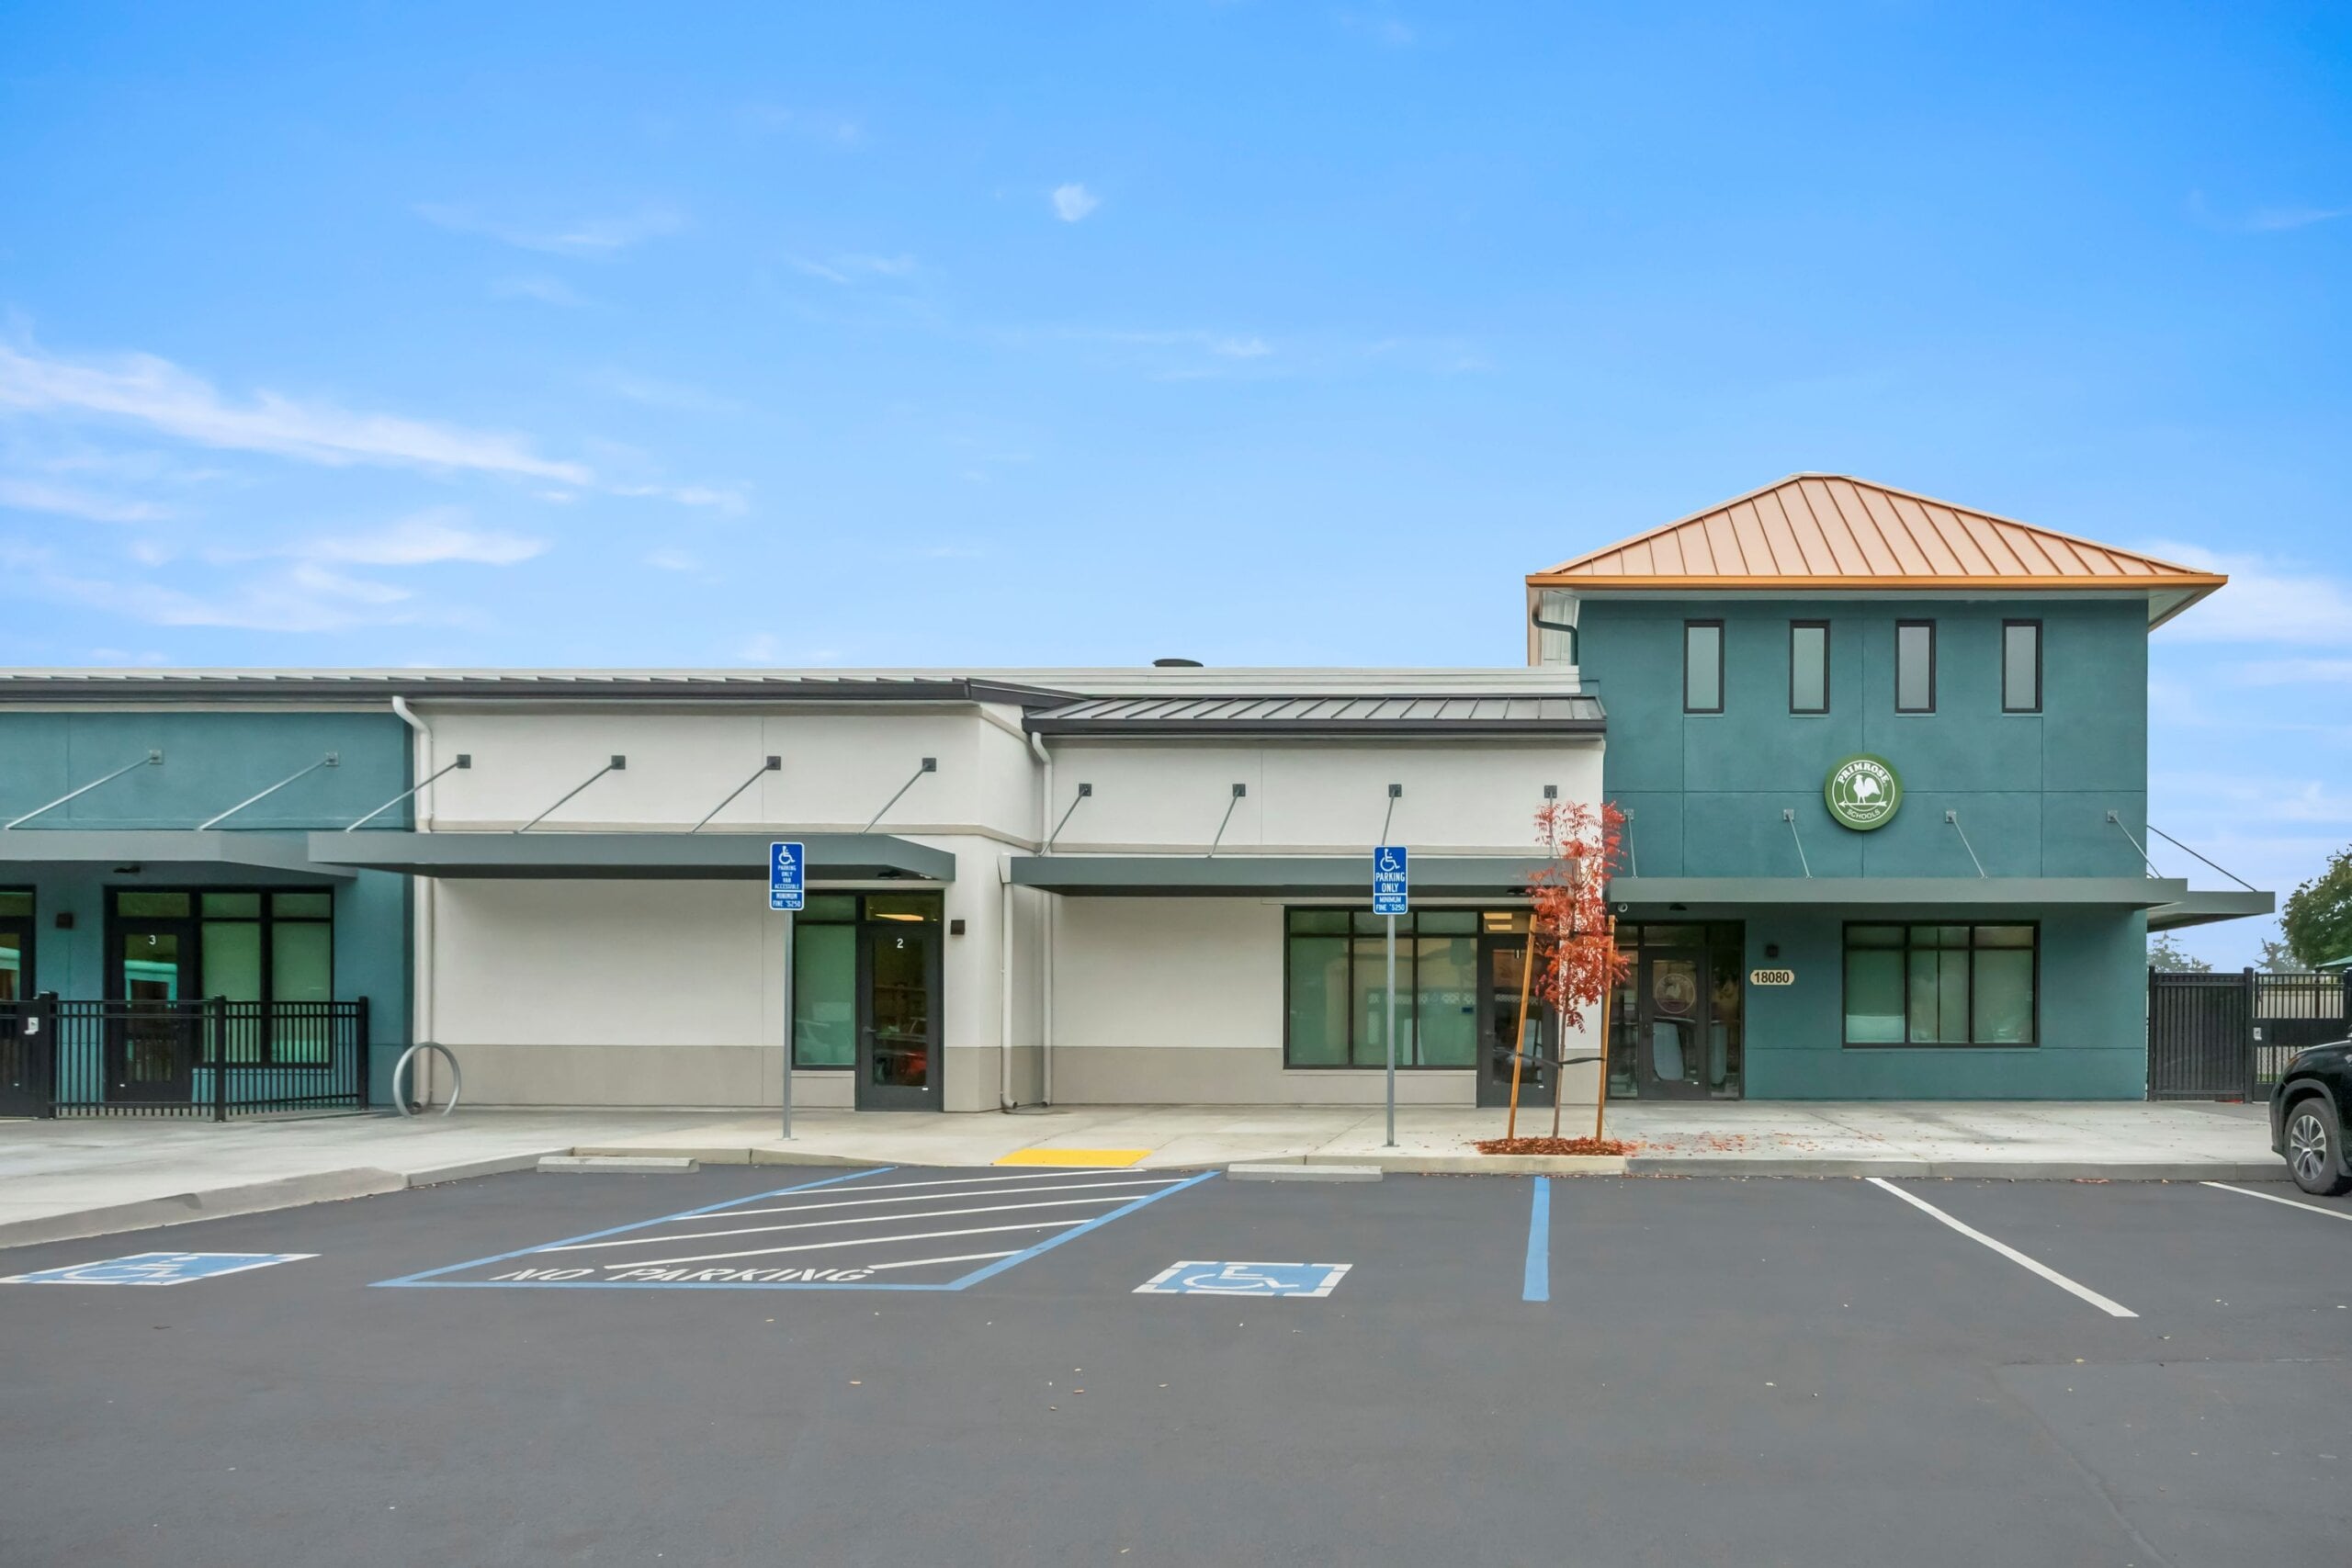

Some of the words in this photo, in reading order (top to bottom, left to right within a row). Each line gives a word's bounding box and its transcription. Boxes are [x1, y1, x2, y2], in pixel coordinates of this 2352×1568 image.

[1838, 762, 1890, 784] PRIMROSE
[1847, 808, 1881, 819] SCHOOLS
[1375, 872, 1405, 882] PARKING
[1381, 883, 1399, 893] ONLY
[148, 934, 156, 945] 3
[897, 938, 904, 949] 2
[1754, 971, 1790, 983] 18080
[488, 1269, 594, 1280] NO
[604, 1269, 876, 1281] PARKING
